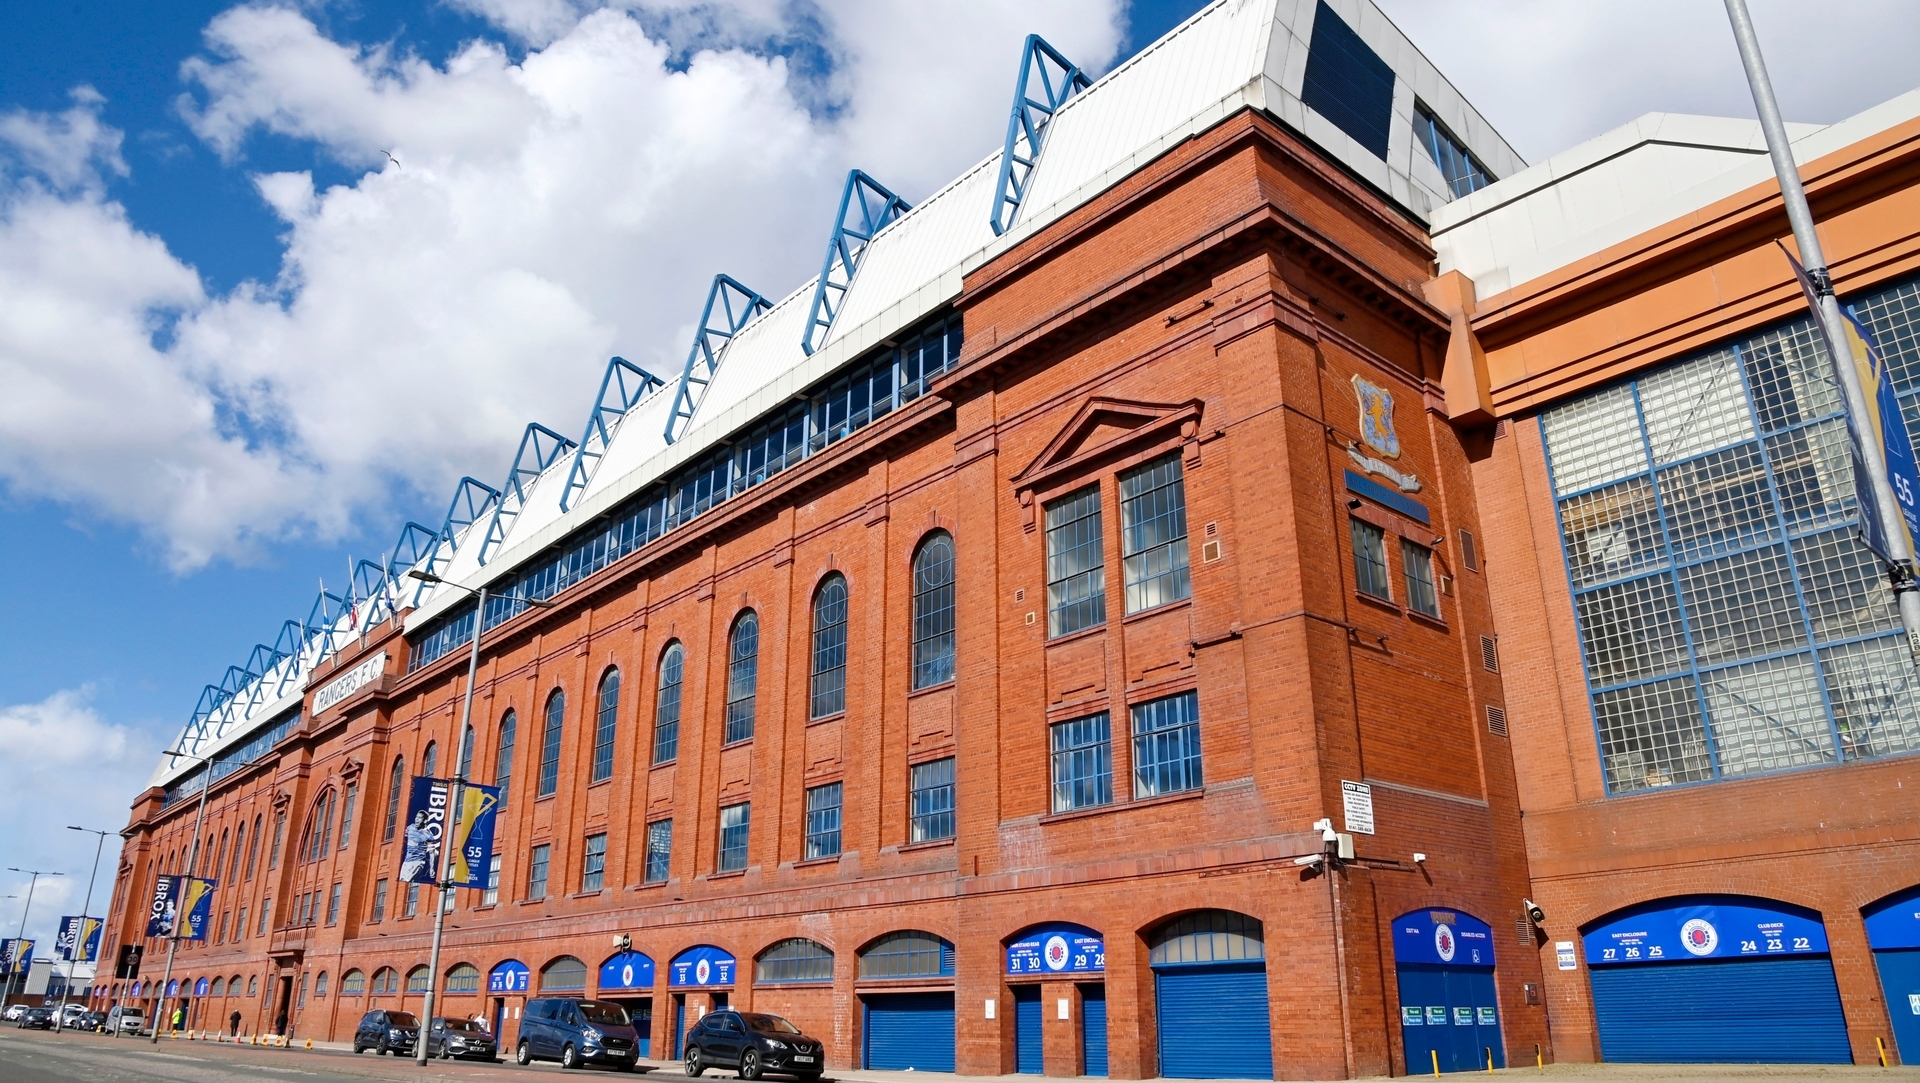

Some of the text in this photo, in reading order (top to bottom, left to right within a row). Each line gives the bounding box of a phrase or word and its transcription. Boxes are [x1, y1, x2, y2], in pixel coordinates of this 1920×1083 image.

[1894, 472, 1914, 507] 55
[318, 671, 358, 710] RANGERS
[1344, 783, 1356, 791] CCTV
[426, 787, 448, 856] IBROX
[467, 846, 482, 858] 55
[150, 879, 170, 921] IBROX
[1685, 921, 1710, 931] RANGERS
[65, 919, 79, 949] IBROX
[1741, 940, 1757, 951] 24
[1767, 939, 1783, 950] 23
[1793, 937, 1810, 948] 22
[1603, 948, 1616, 958] 27
[1625, 947, 1640, 957] 26
[1649, 945, 1663, 956] 25
[1011, 958, 1020, 969] 31
[1028, 957, 1040, 969] 30
[1074, 954, 1087, 966] 29
[1095, 953, 1105, 965] 28
[679, 973, 686, 982] 33
[720, 972, 728, 981] 32
